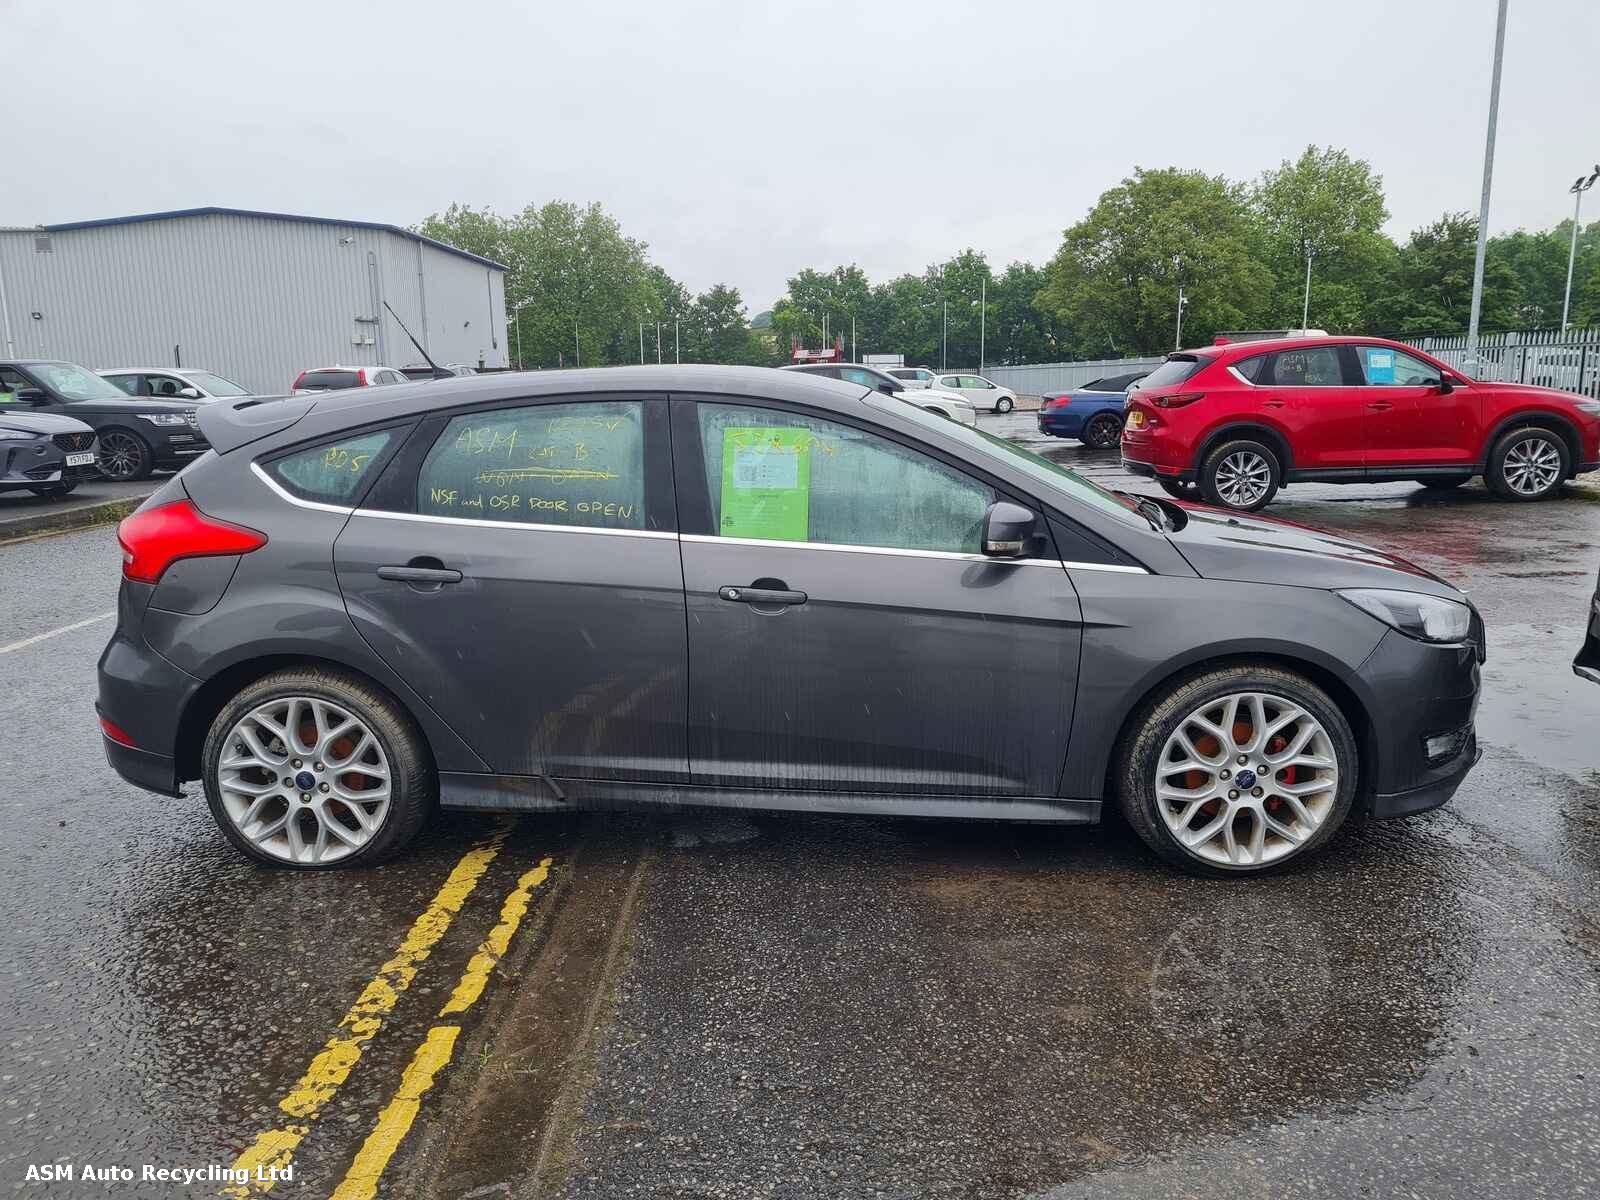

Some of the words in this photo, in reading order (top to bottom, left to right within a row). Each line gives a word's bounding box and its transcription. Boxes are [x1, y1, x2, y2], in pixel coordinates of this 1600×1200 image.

[455, 426, 522, 456] ASM
[430, 488, 458, 506] NSF
[461, 497, 483, 509] and
[489, 494, 521, 509] OSR
[529, 497, 568, 512] DOOR
[576, 502, 632, 520] OPEN
